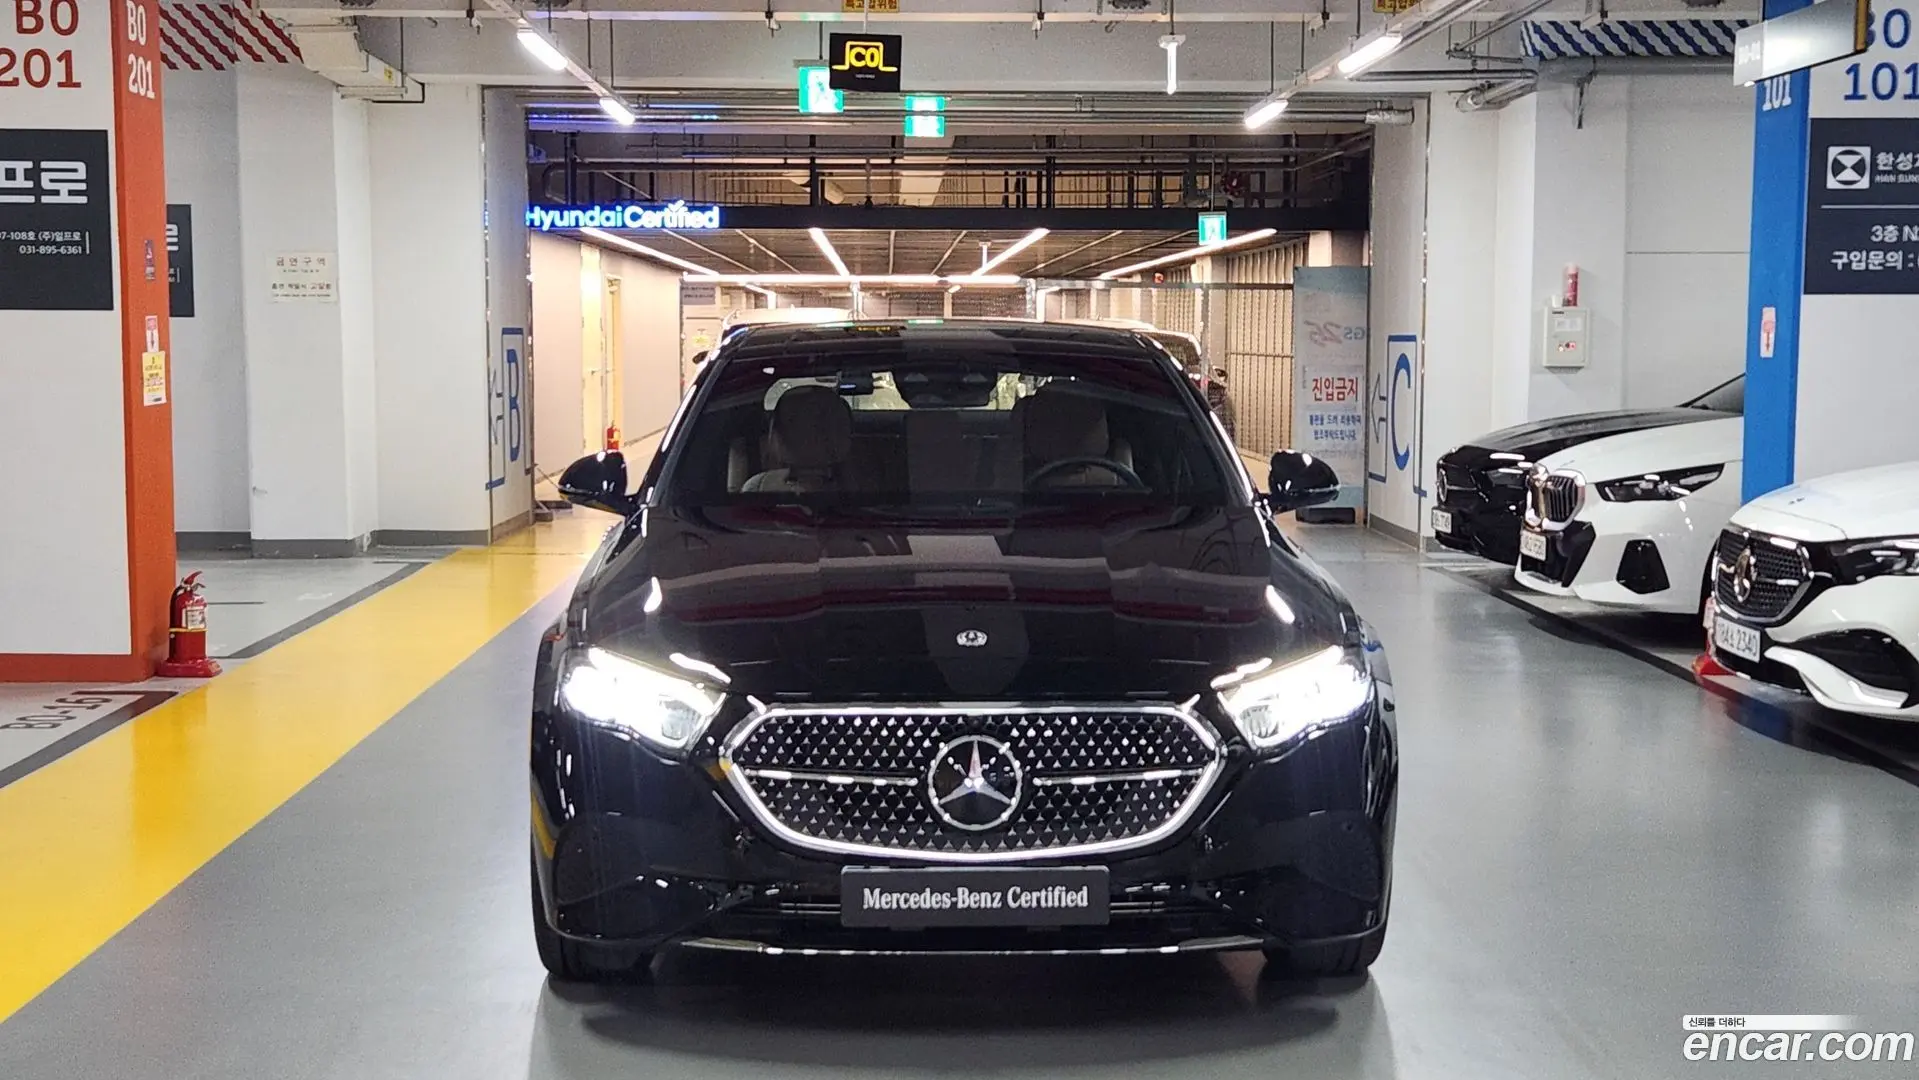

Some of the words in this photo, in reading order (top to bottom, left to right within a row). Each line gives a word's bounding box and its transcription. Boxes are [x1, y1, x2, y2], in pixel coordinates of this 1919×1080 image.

[0, 48, 82, 88] 201
[128, 53, 155, 100] 201
[1844, 62, 1919, 100] 101
[1762, 74, 1792, 112] 101
[526, 205, 622, 231] Hyundai
[624, 201, 720, 228] Certified
[19, 245, 82, 255] 031-895-6361
[1871, 225, 1900, 243] 3층
[1830, 250, 1903, 270] 구입문의
[506, 349, 520, 462] B
[1311, 377, 1359, 402] 진입금지
[1391, 352, 1411, 471] C
[862, 886, 1002, 910] Mercedes-Benz
[1006, 885, 1089, 909] Certified
